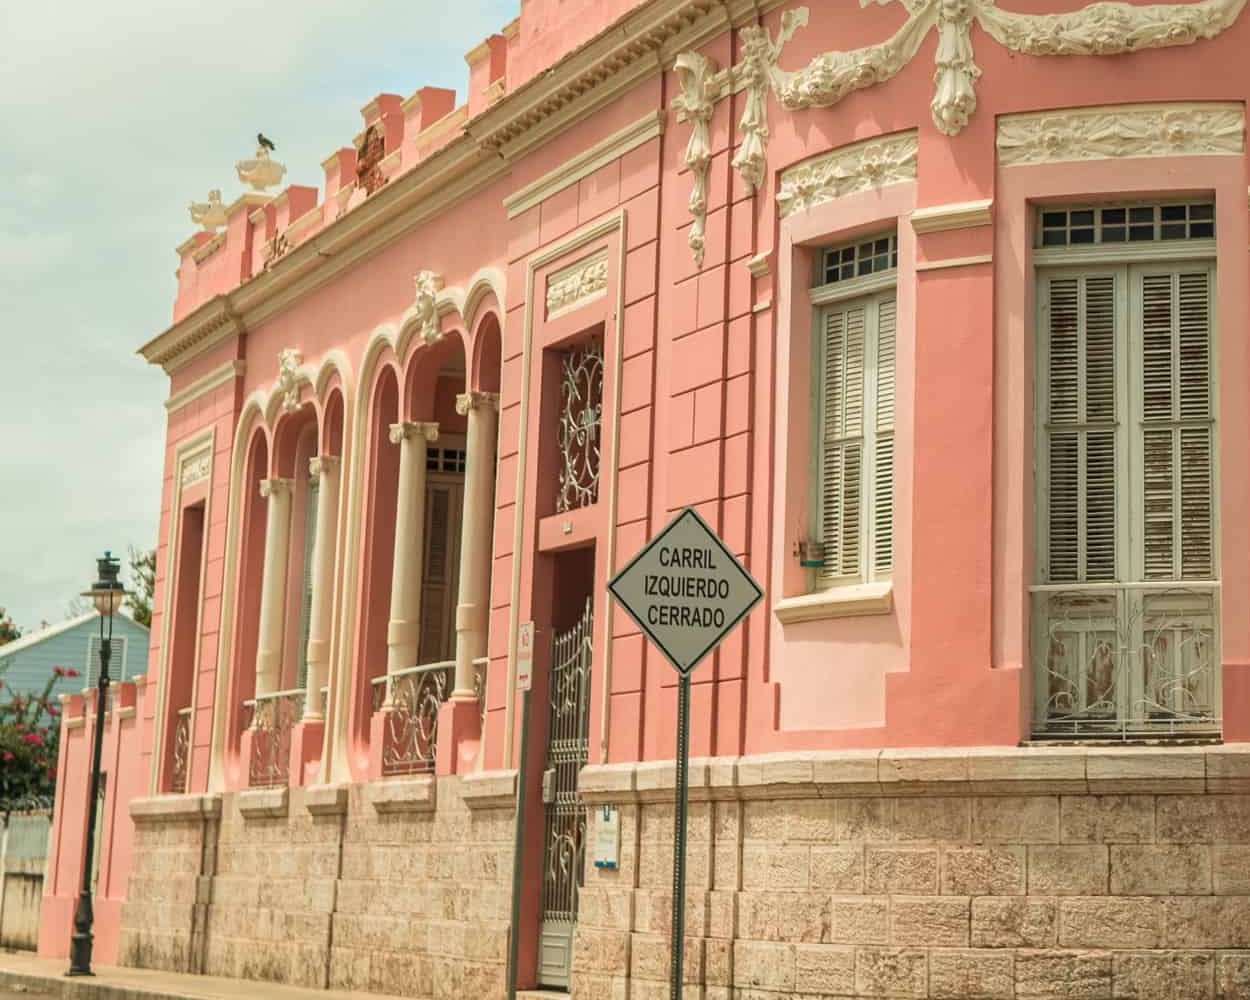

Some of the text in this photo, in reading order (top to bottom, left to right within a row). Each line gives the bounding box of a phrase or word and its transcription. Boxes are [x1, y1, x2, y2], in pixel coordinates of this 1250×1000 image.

[659, 547, 717, 569] CARRIL
[645, 575, 729, 599] IZQUIERDO
[647, 605, 725, 628] CERRADO
